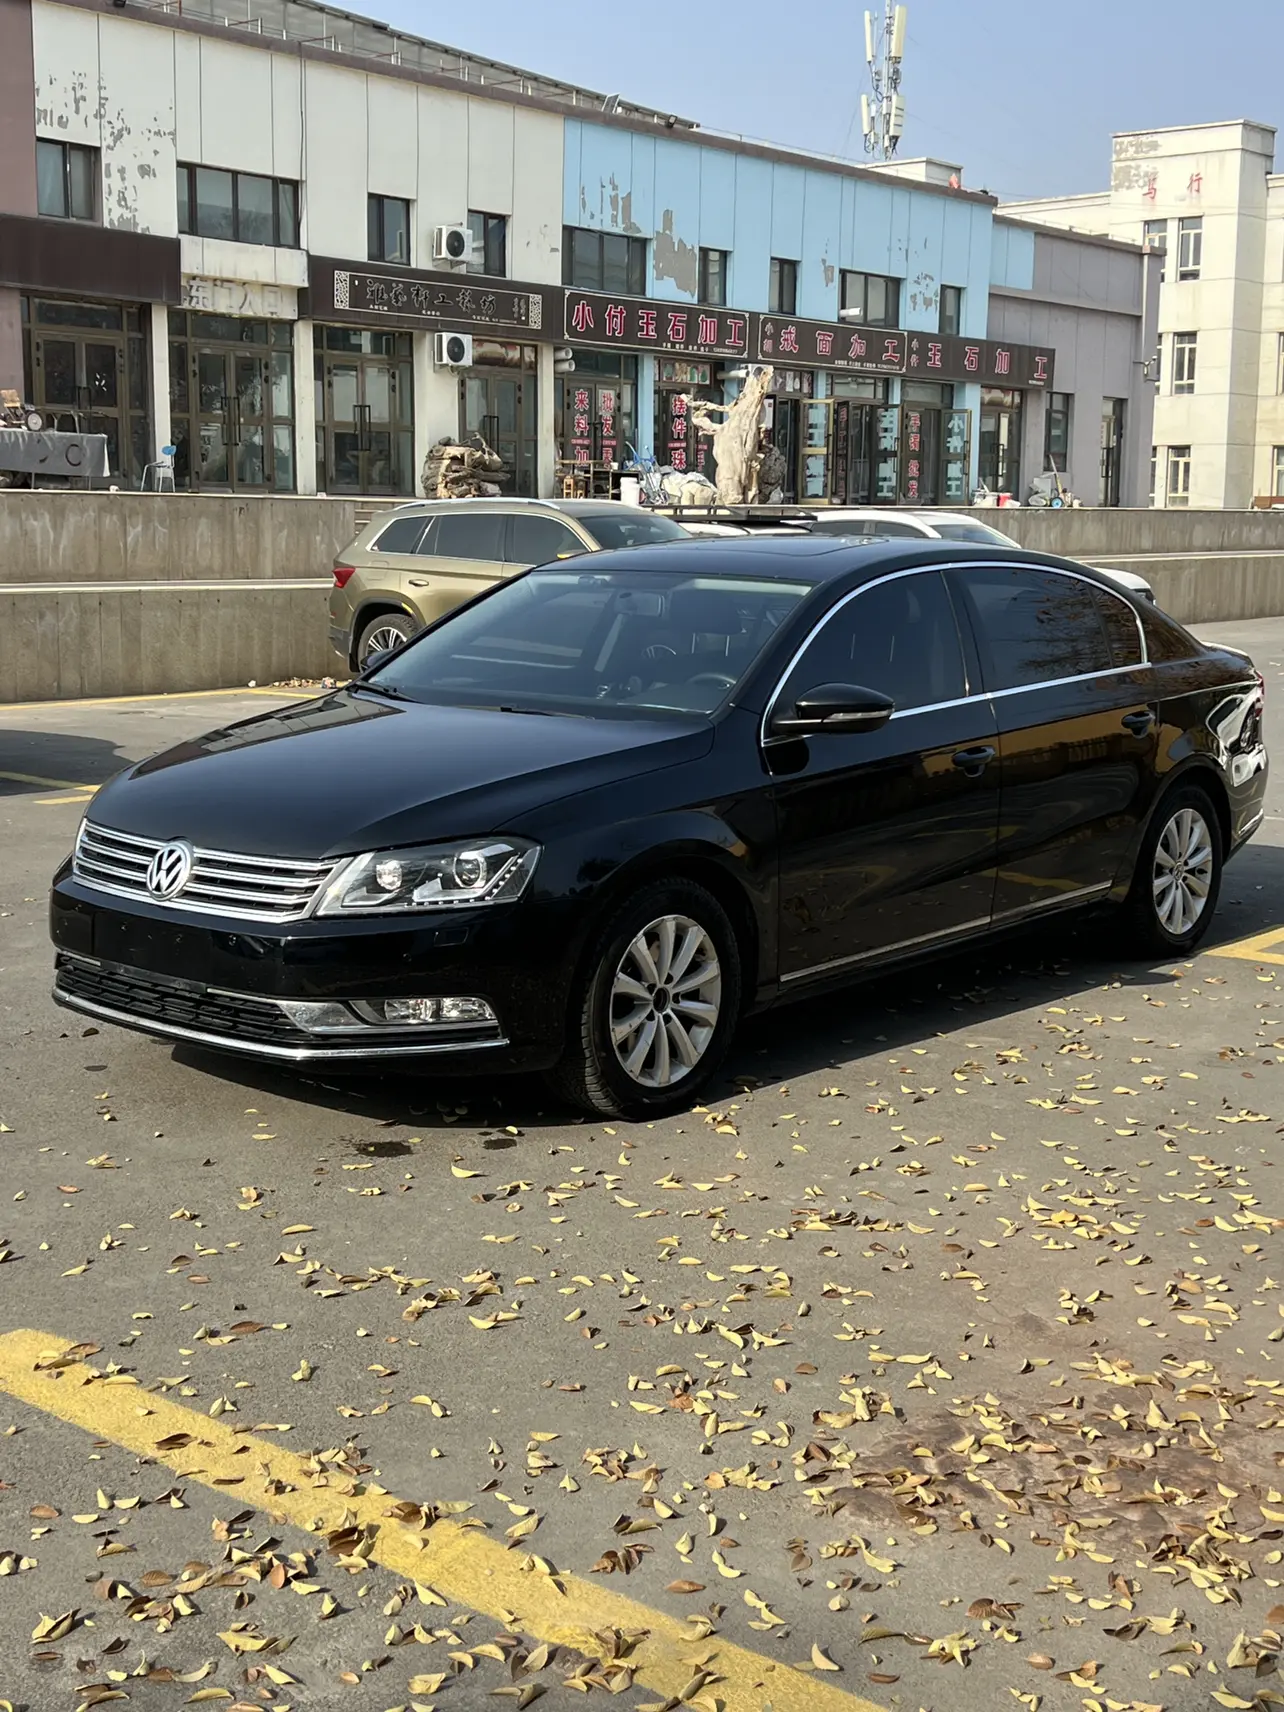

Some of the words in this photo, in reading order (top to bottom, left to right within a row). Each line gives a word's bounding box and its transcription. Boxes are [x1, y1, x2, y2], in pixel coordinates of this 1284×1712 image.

[572, 300, 744, 347] 小付玉石加工
[779, 325, 900, 362] 戒面加工
[926, 342, 1048, 379] 玉石加工
